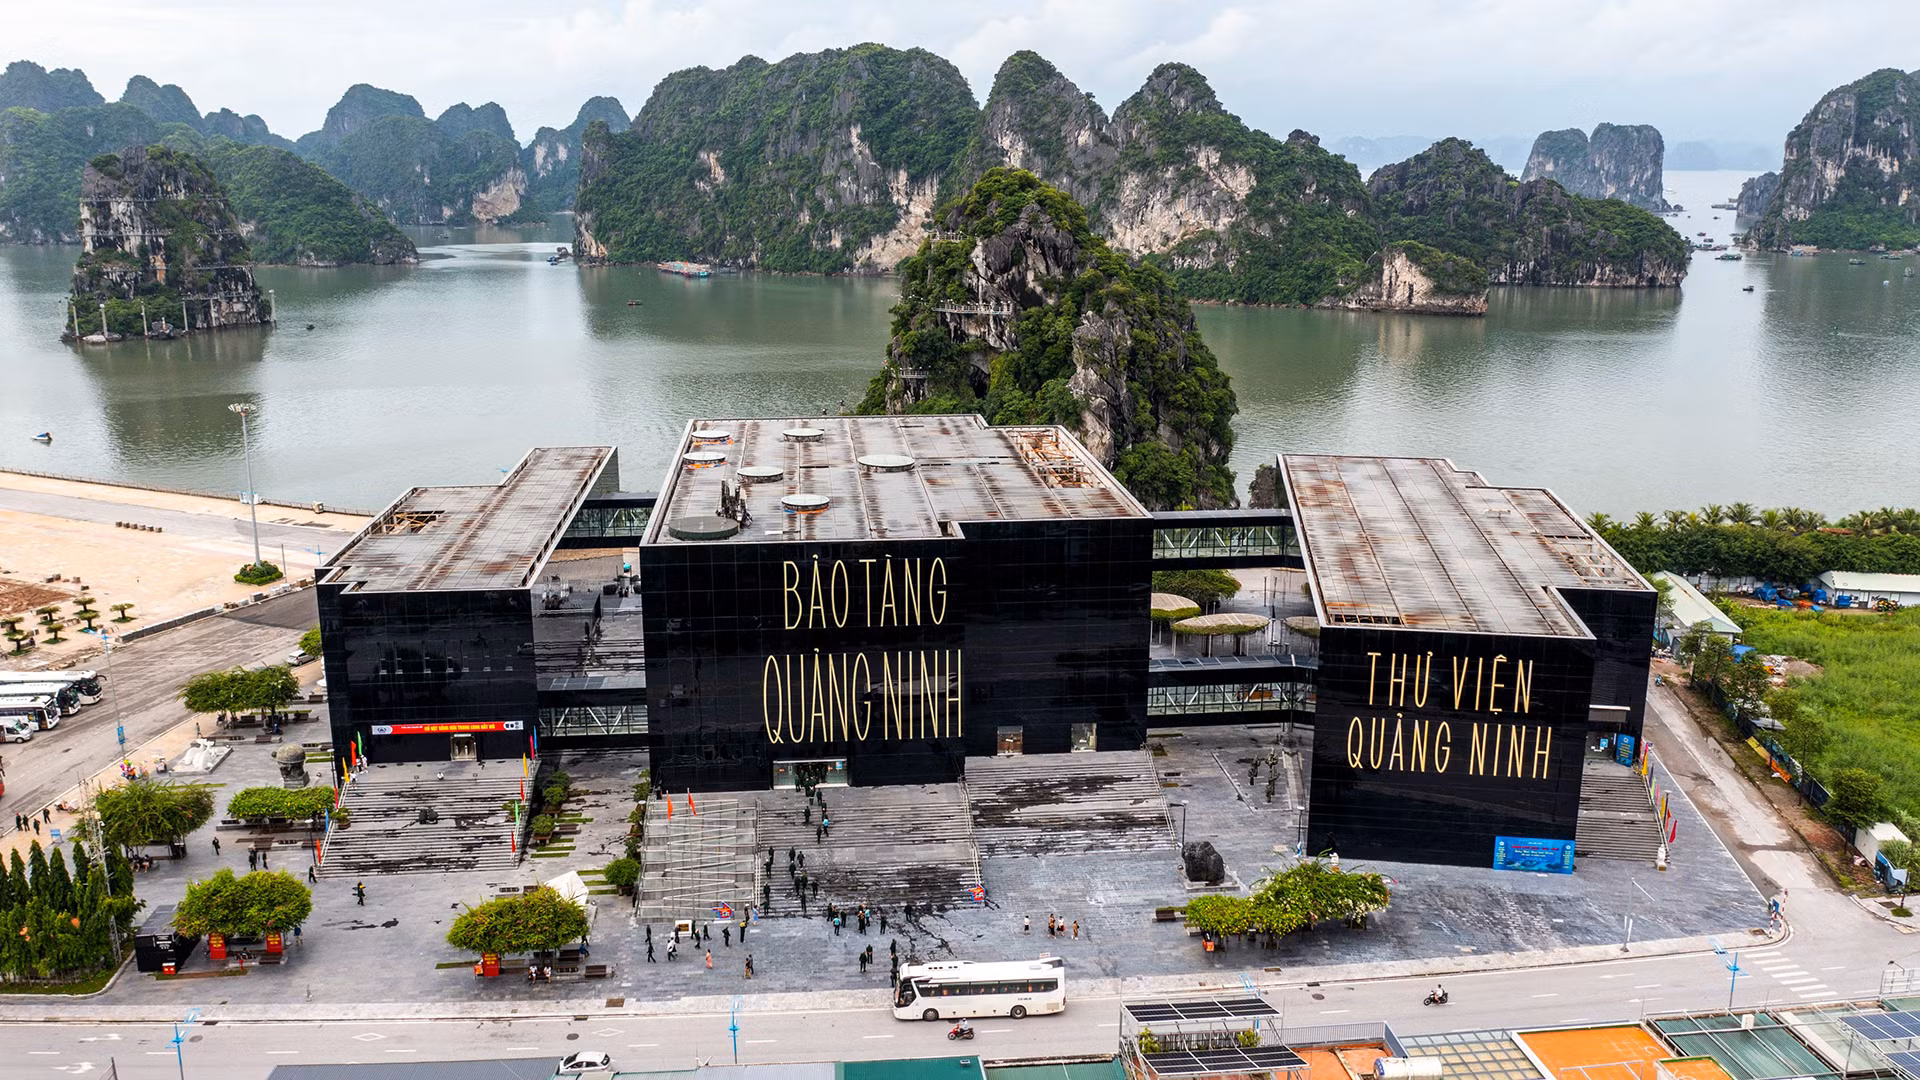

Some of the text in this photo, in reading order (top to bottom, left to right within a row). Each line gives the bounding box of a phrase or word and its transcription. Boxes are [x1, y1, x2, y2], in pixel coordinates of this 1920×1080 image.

[783, 553, 947, 630] BẢO TÀNG
[763, 647, 962, 744] QUẢNG NINH
[1367, 651, 1534, 715] THƯ VIỆN
[1347, 712, 1552, 780] QUẢNG NINH
